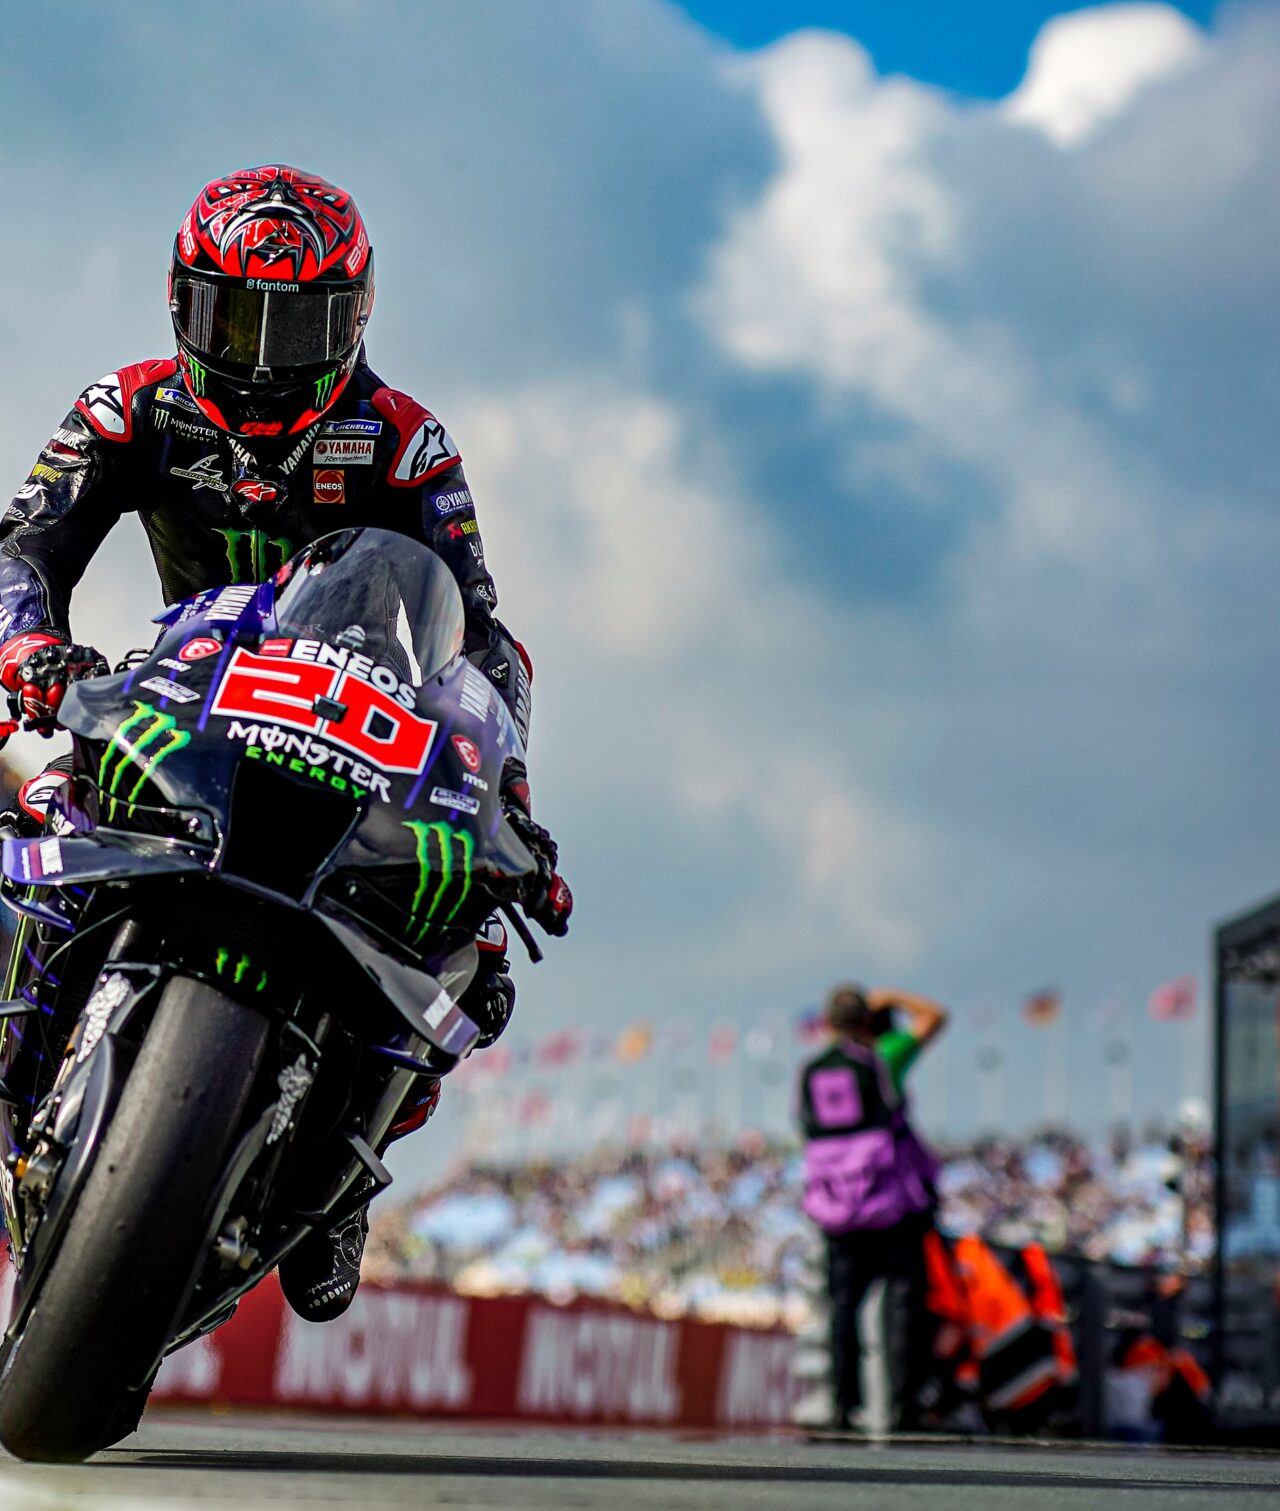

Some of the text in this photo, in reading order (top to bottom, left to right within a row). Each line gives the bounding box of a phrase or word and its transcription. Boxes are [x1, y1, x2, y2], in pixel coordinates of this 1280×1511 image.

[256, 279, 300, 294] fantom
[175, 395, 197, 409] MICH
[170, 418, 219, 439] MONSTER
[336, 423, 376, 432] MICHELIN
[329, 441, 372, 455] YAMAHA
[315, 482, 343, 491] ENEOS
[291, 639, 418, 710] ENEOS
[210, 646, 438, 775] 20
[227, 720, 392, 804] MONSTER
[245, 745, 367, 800] ENERGY
[462, 772, 488, 792] msi
